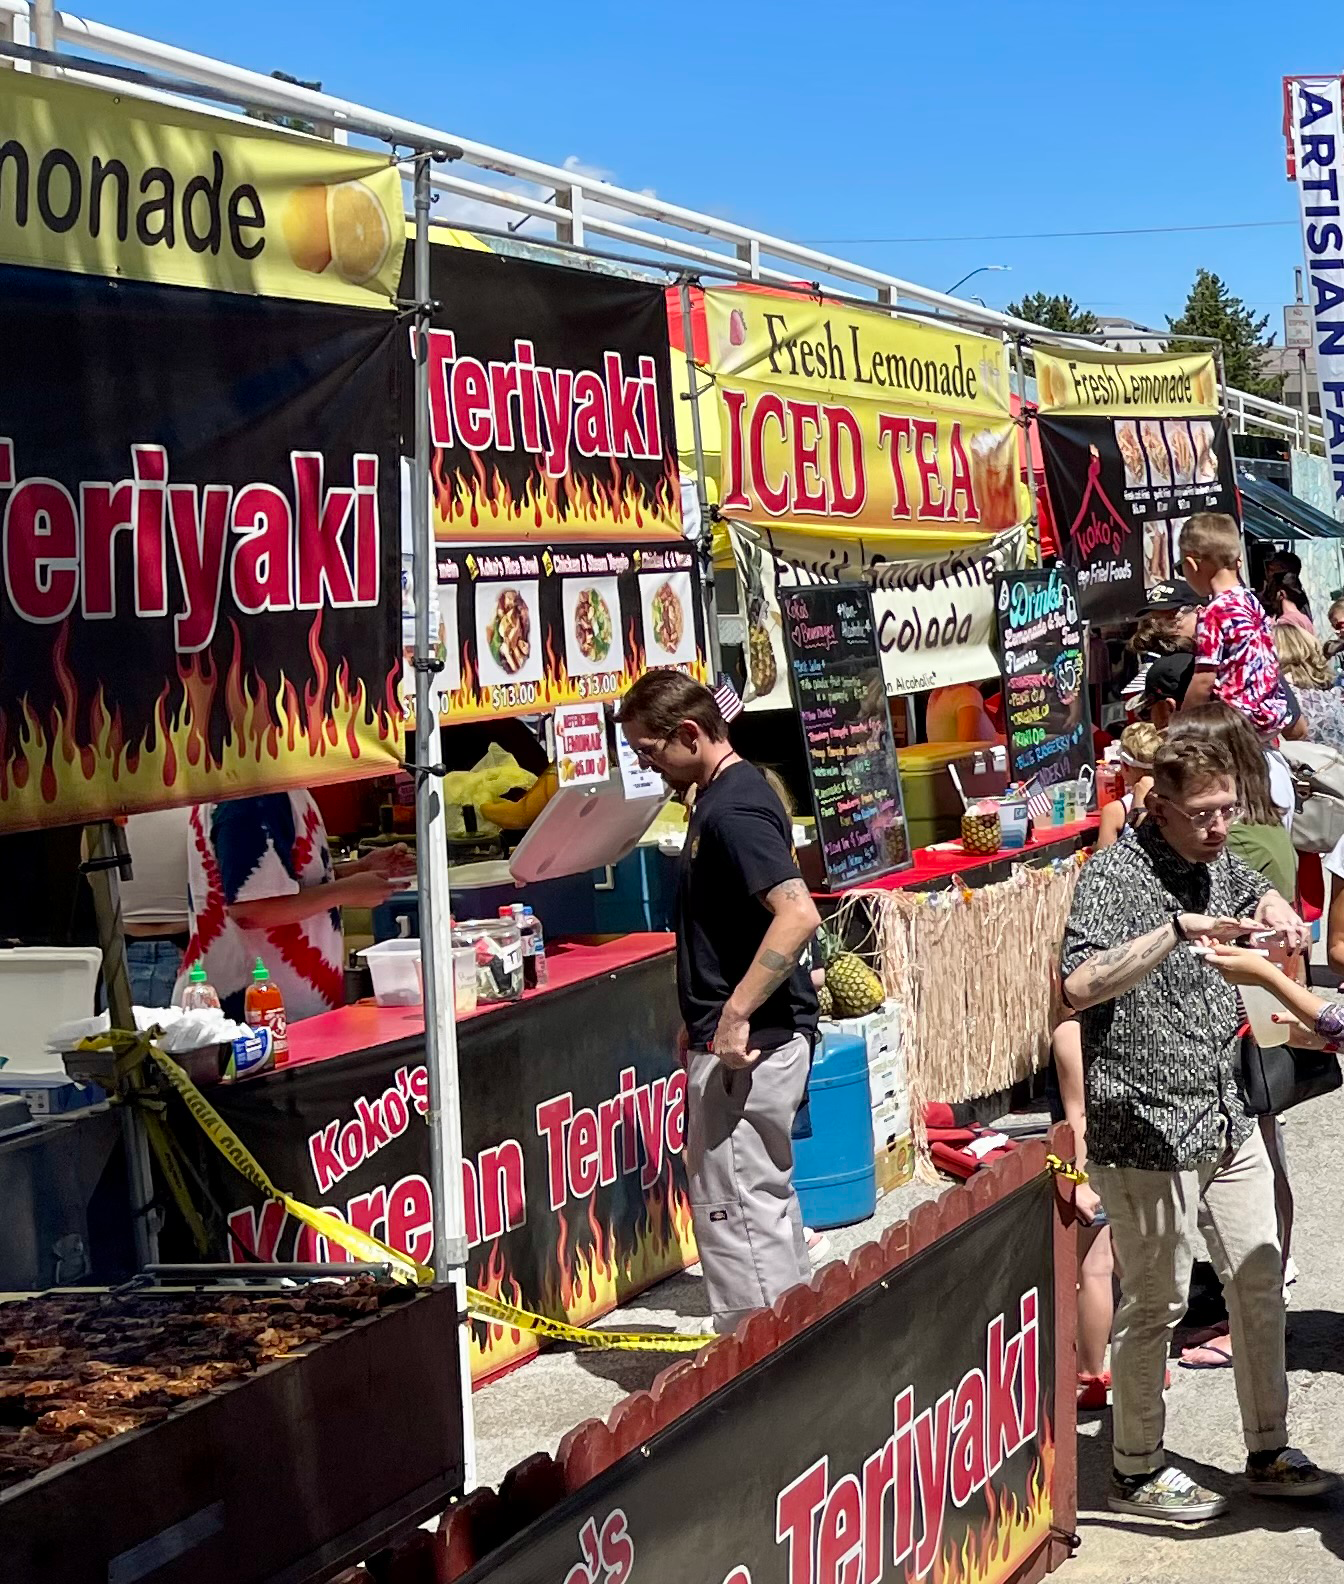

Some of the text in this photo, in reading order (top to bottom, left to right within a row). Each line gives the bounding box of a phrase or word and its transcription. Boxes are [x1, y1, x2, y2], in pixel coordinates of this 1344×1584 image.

[409, 326, 663, 479] Teriyaki
[763, 313, 977, 400] Fresh Lemonade
[1068, 362, 1192, 405] Fresh Lemonade
[721, 388, 981, 523] ICED TEA
[879, 603, 972, 652] Colada
[493, 684, 535, 708] $13.00
[579, 675, 616, 697] $13.00
[308, 1065, 428, 1195] Koko's
[536, 1065, 688, 1212] Teriya
[776, 1287, 1040, 1584] Teriyaki
